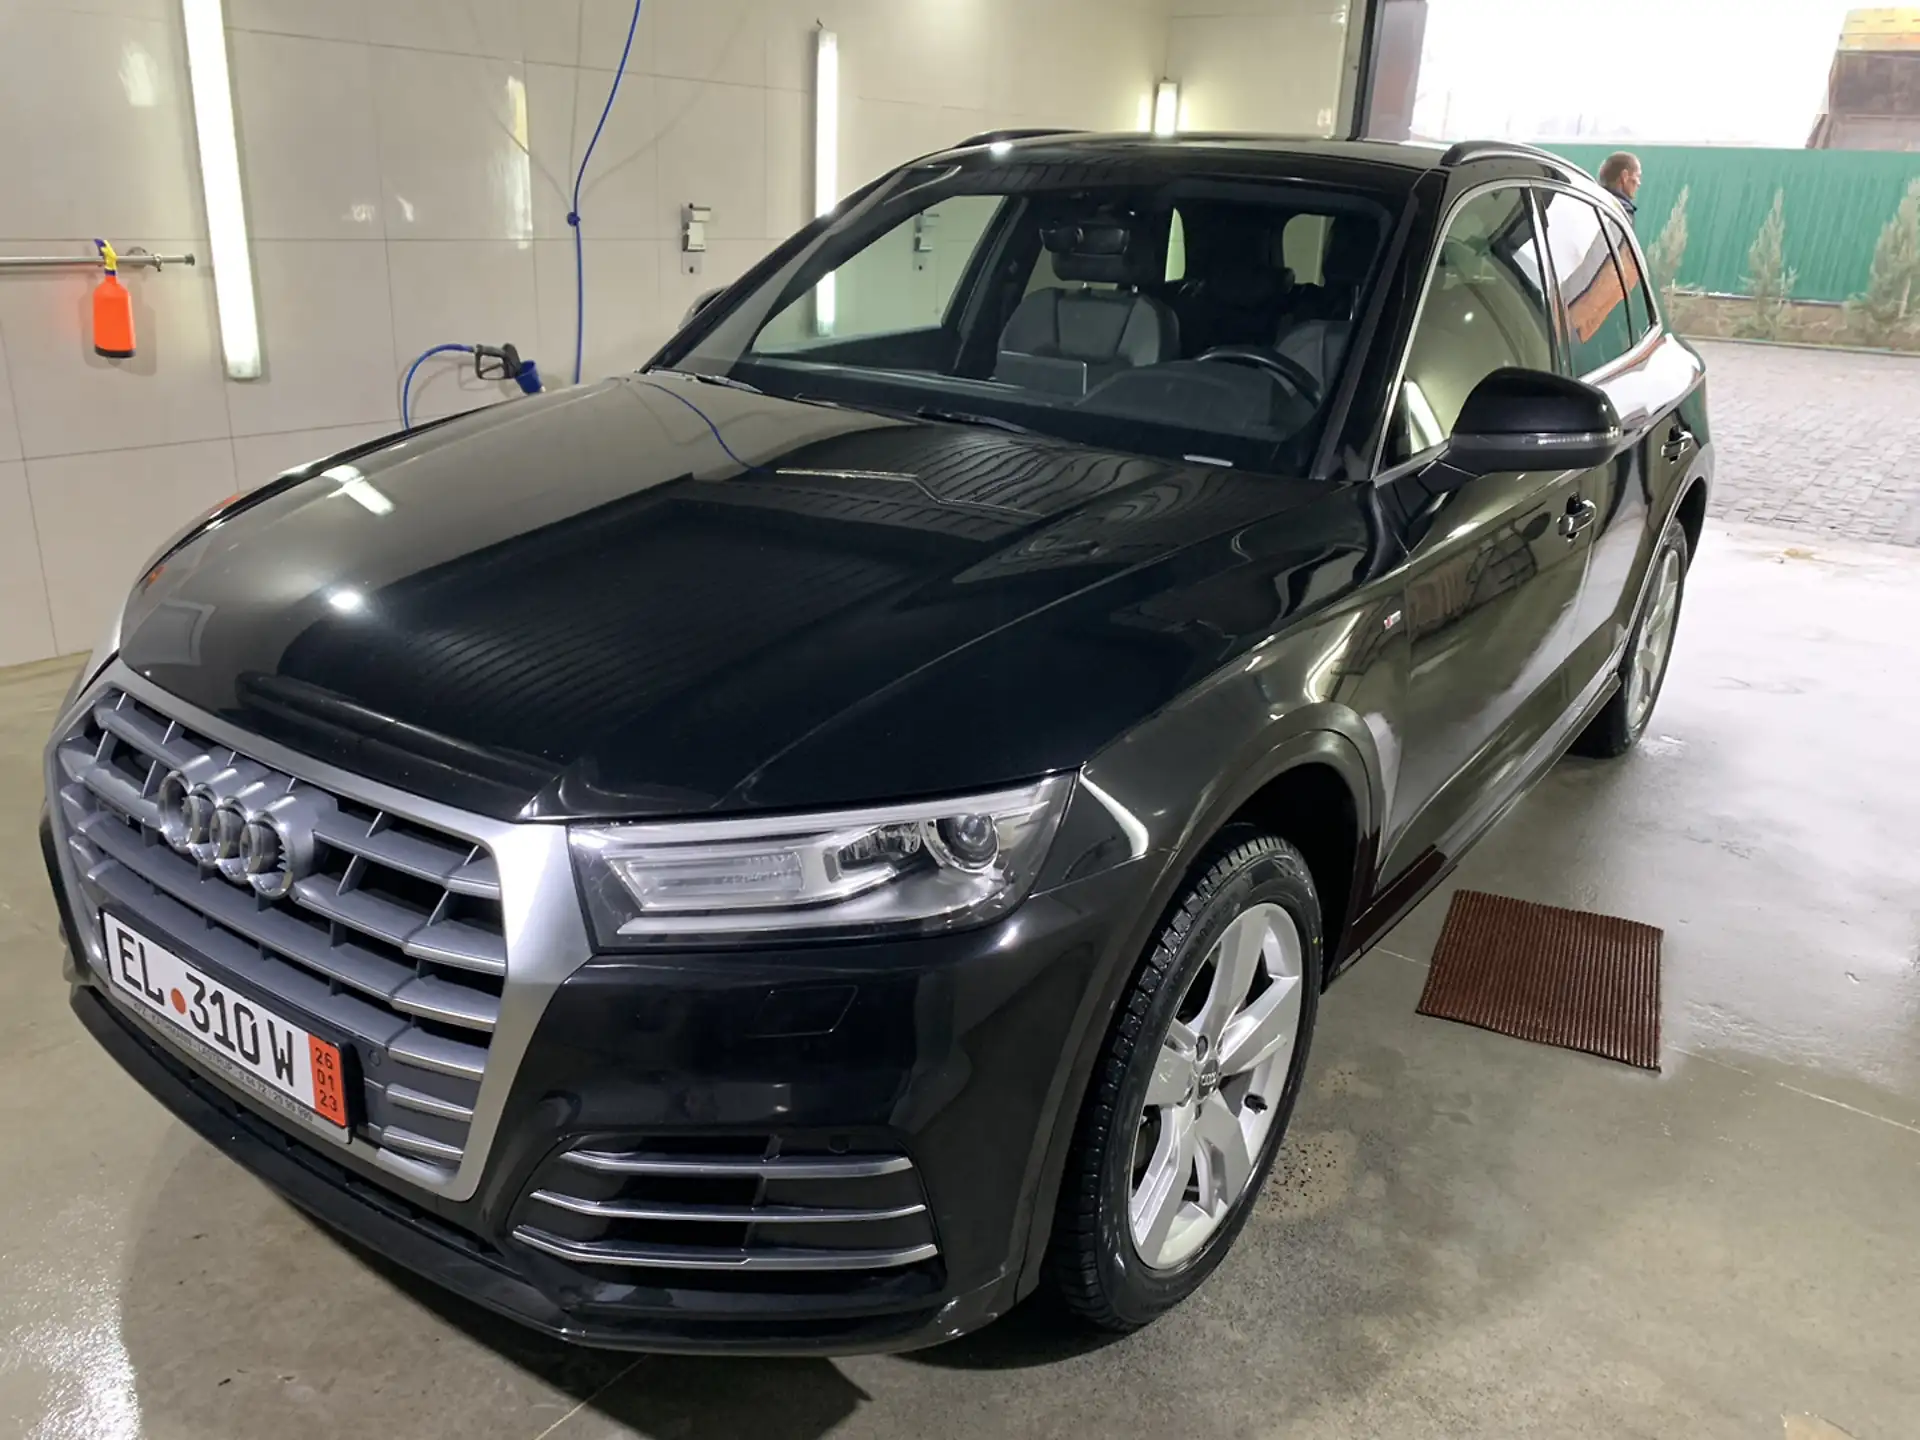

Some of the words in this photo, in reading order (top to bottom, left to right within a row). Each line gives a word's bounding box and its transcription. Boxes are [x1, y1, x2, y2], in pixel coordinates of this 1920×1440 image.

[116, 928, 164, 1006] EL
[315, 1047, 333, 1070] 26
[317, 1068, 335, 1092] 01
[319, 1089, 338, 1112] 23
